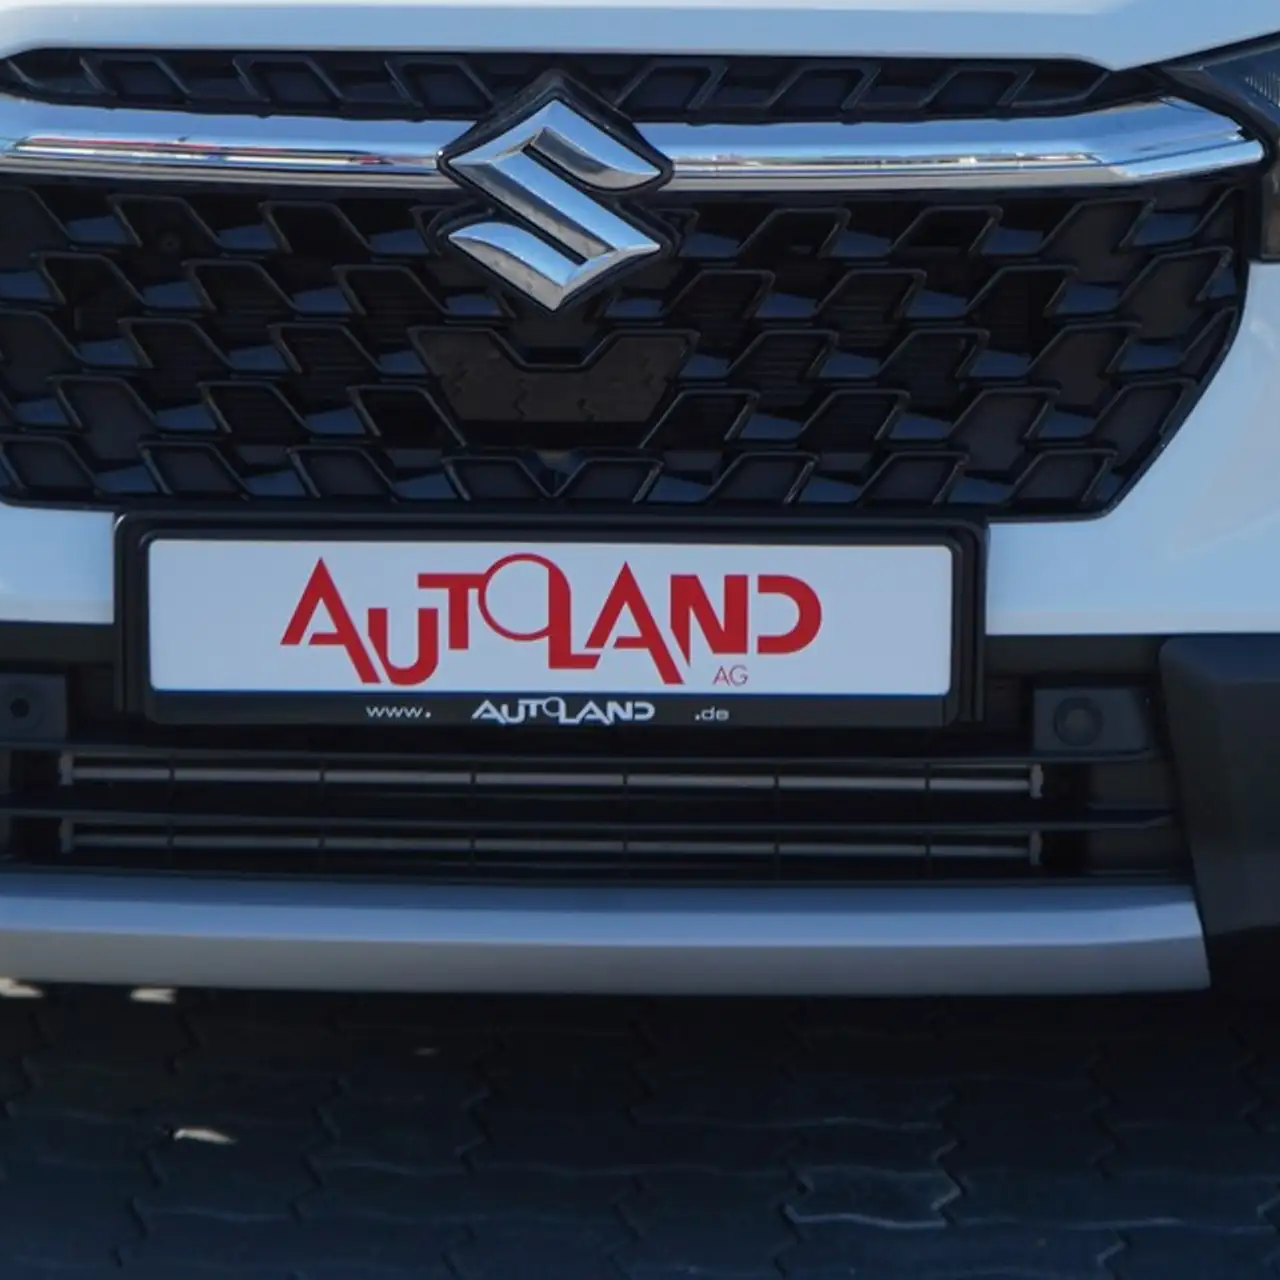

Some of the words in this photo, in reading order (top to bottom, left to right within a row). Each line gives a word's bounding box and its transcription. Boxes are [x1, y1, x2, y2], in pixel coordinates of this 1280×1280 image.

[712, 665, 748, 685] AG
[366, 706, 432, 718] www.
[695, 707, 730, 720] .de
